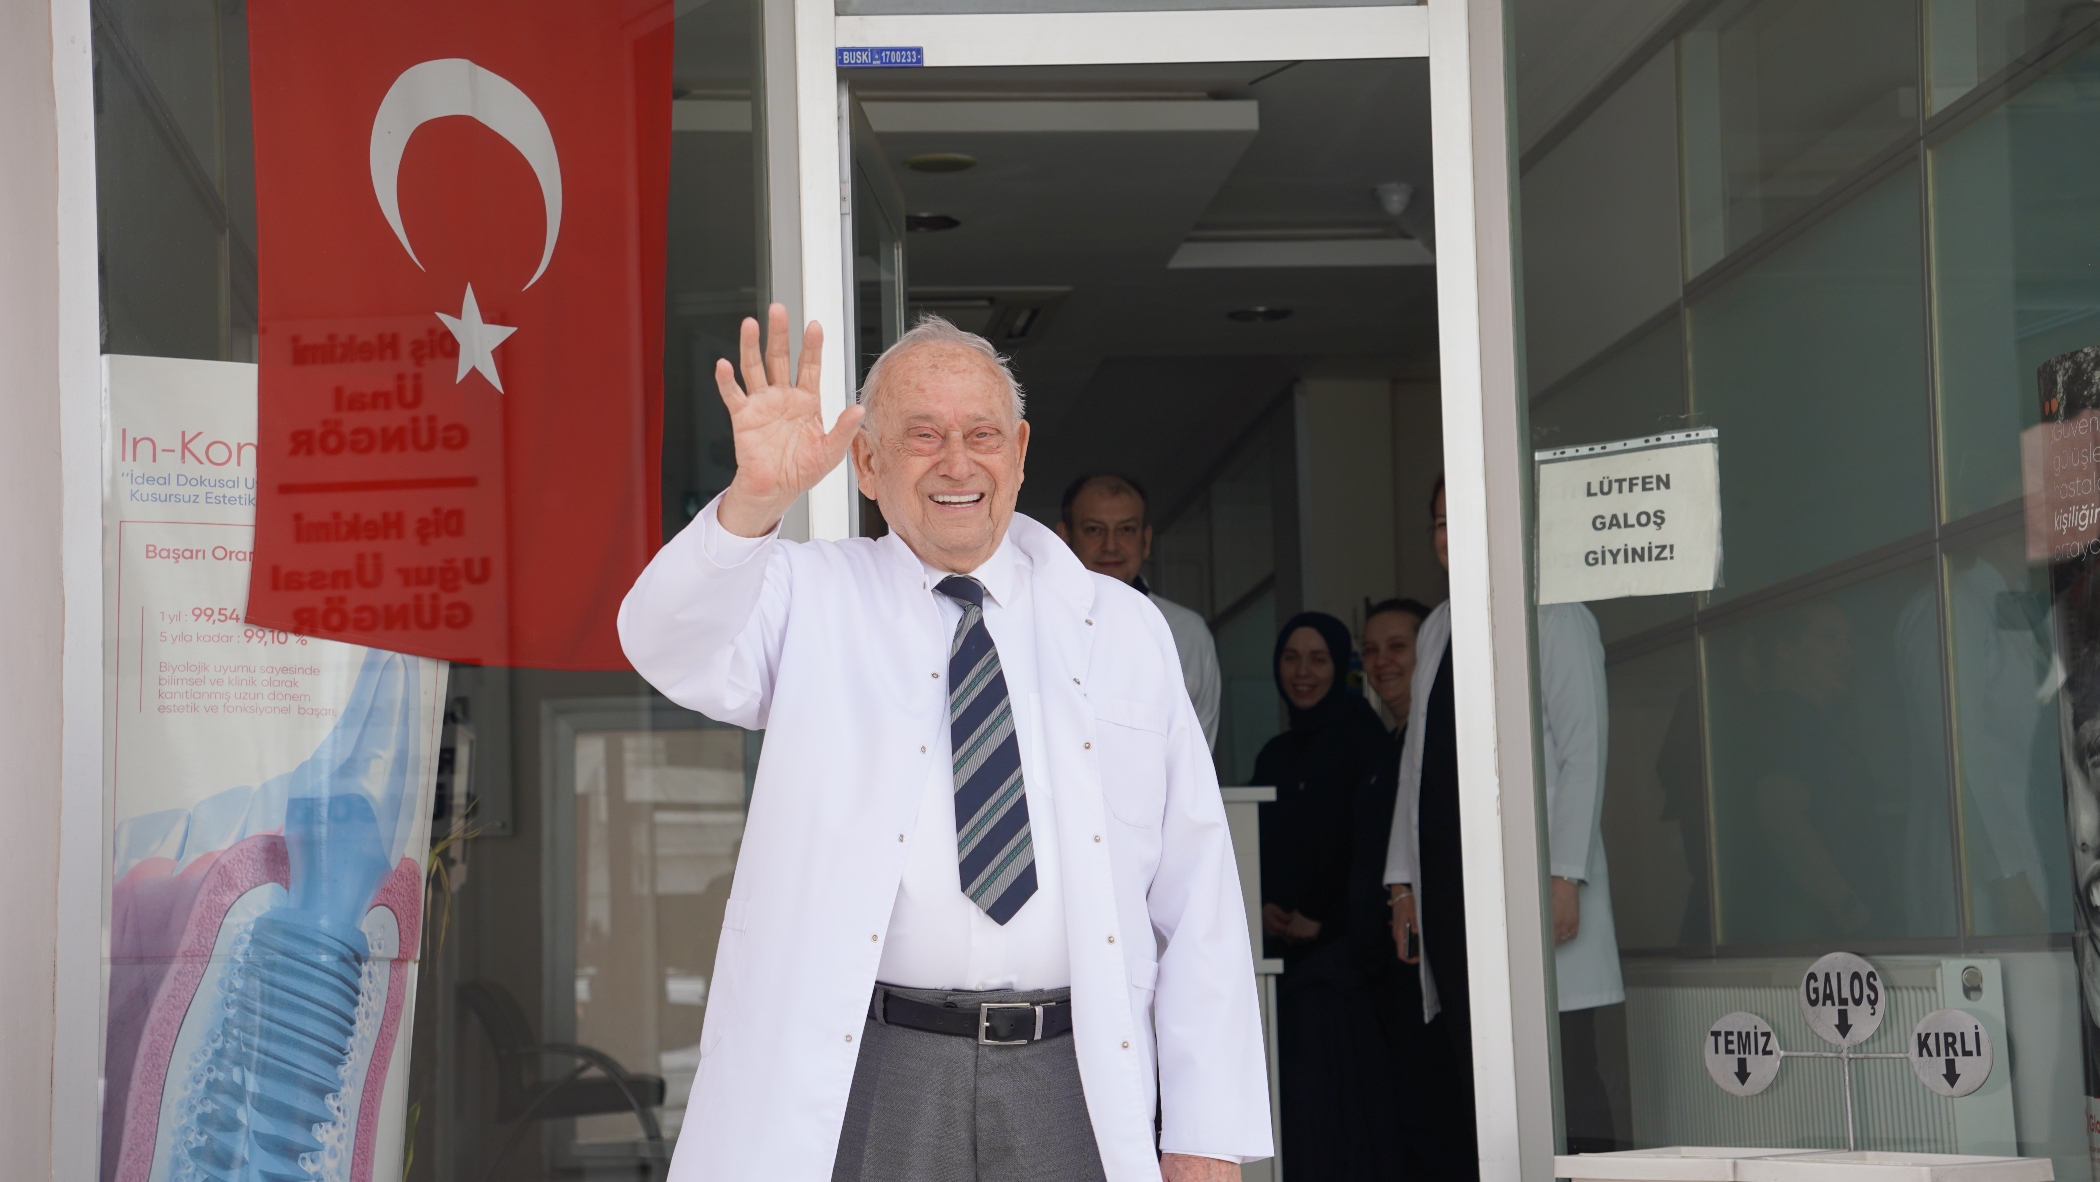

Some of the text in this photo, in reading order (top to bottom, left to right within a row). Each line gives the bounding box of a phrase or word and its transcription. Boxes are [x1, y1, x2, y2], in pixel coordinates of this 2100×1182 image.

[843, 49, 917, 64] BUSKİ 1700233
[176, 473, 240, 489] Dokusal
[244, 477, 256, 490] U
[1586, 473, 1671, 498] LÜTFEN
[130, 489, 256, 507] Kusursuz Estetik
[1591, 509, 1666, 531] GALOŞ
[145, 543, 206, 563] Başarı
[1584, 541, 1675, 567] GİYİNİZ!
[191, 606, 241, 625] 99,54
[159, 631, 167, 643] 5
[171, 631, 193, 644] yıla
[196, 632, 234, 643] kadar
[243, 628, 288, 647] 99,10
[159, 661, 320, 677] Biyolojik uyumu sayesinde
[158, 675, 300, 689] bilimsel ve klinik olarak
[158, 689, 311, 702] kanıtlanmış uzun dönem
[157, 702, 200, 714] estetik
[203, 705, 219, 714] ve
[222, 703, 291, 717] fonksiyonel
[1805, 970, 1879, 1016] GALOŞ
[1710, 1024, 1774, 1056] TEMİZ
[1917, 1024, 1982, 1058] KIRLİ
